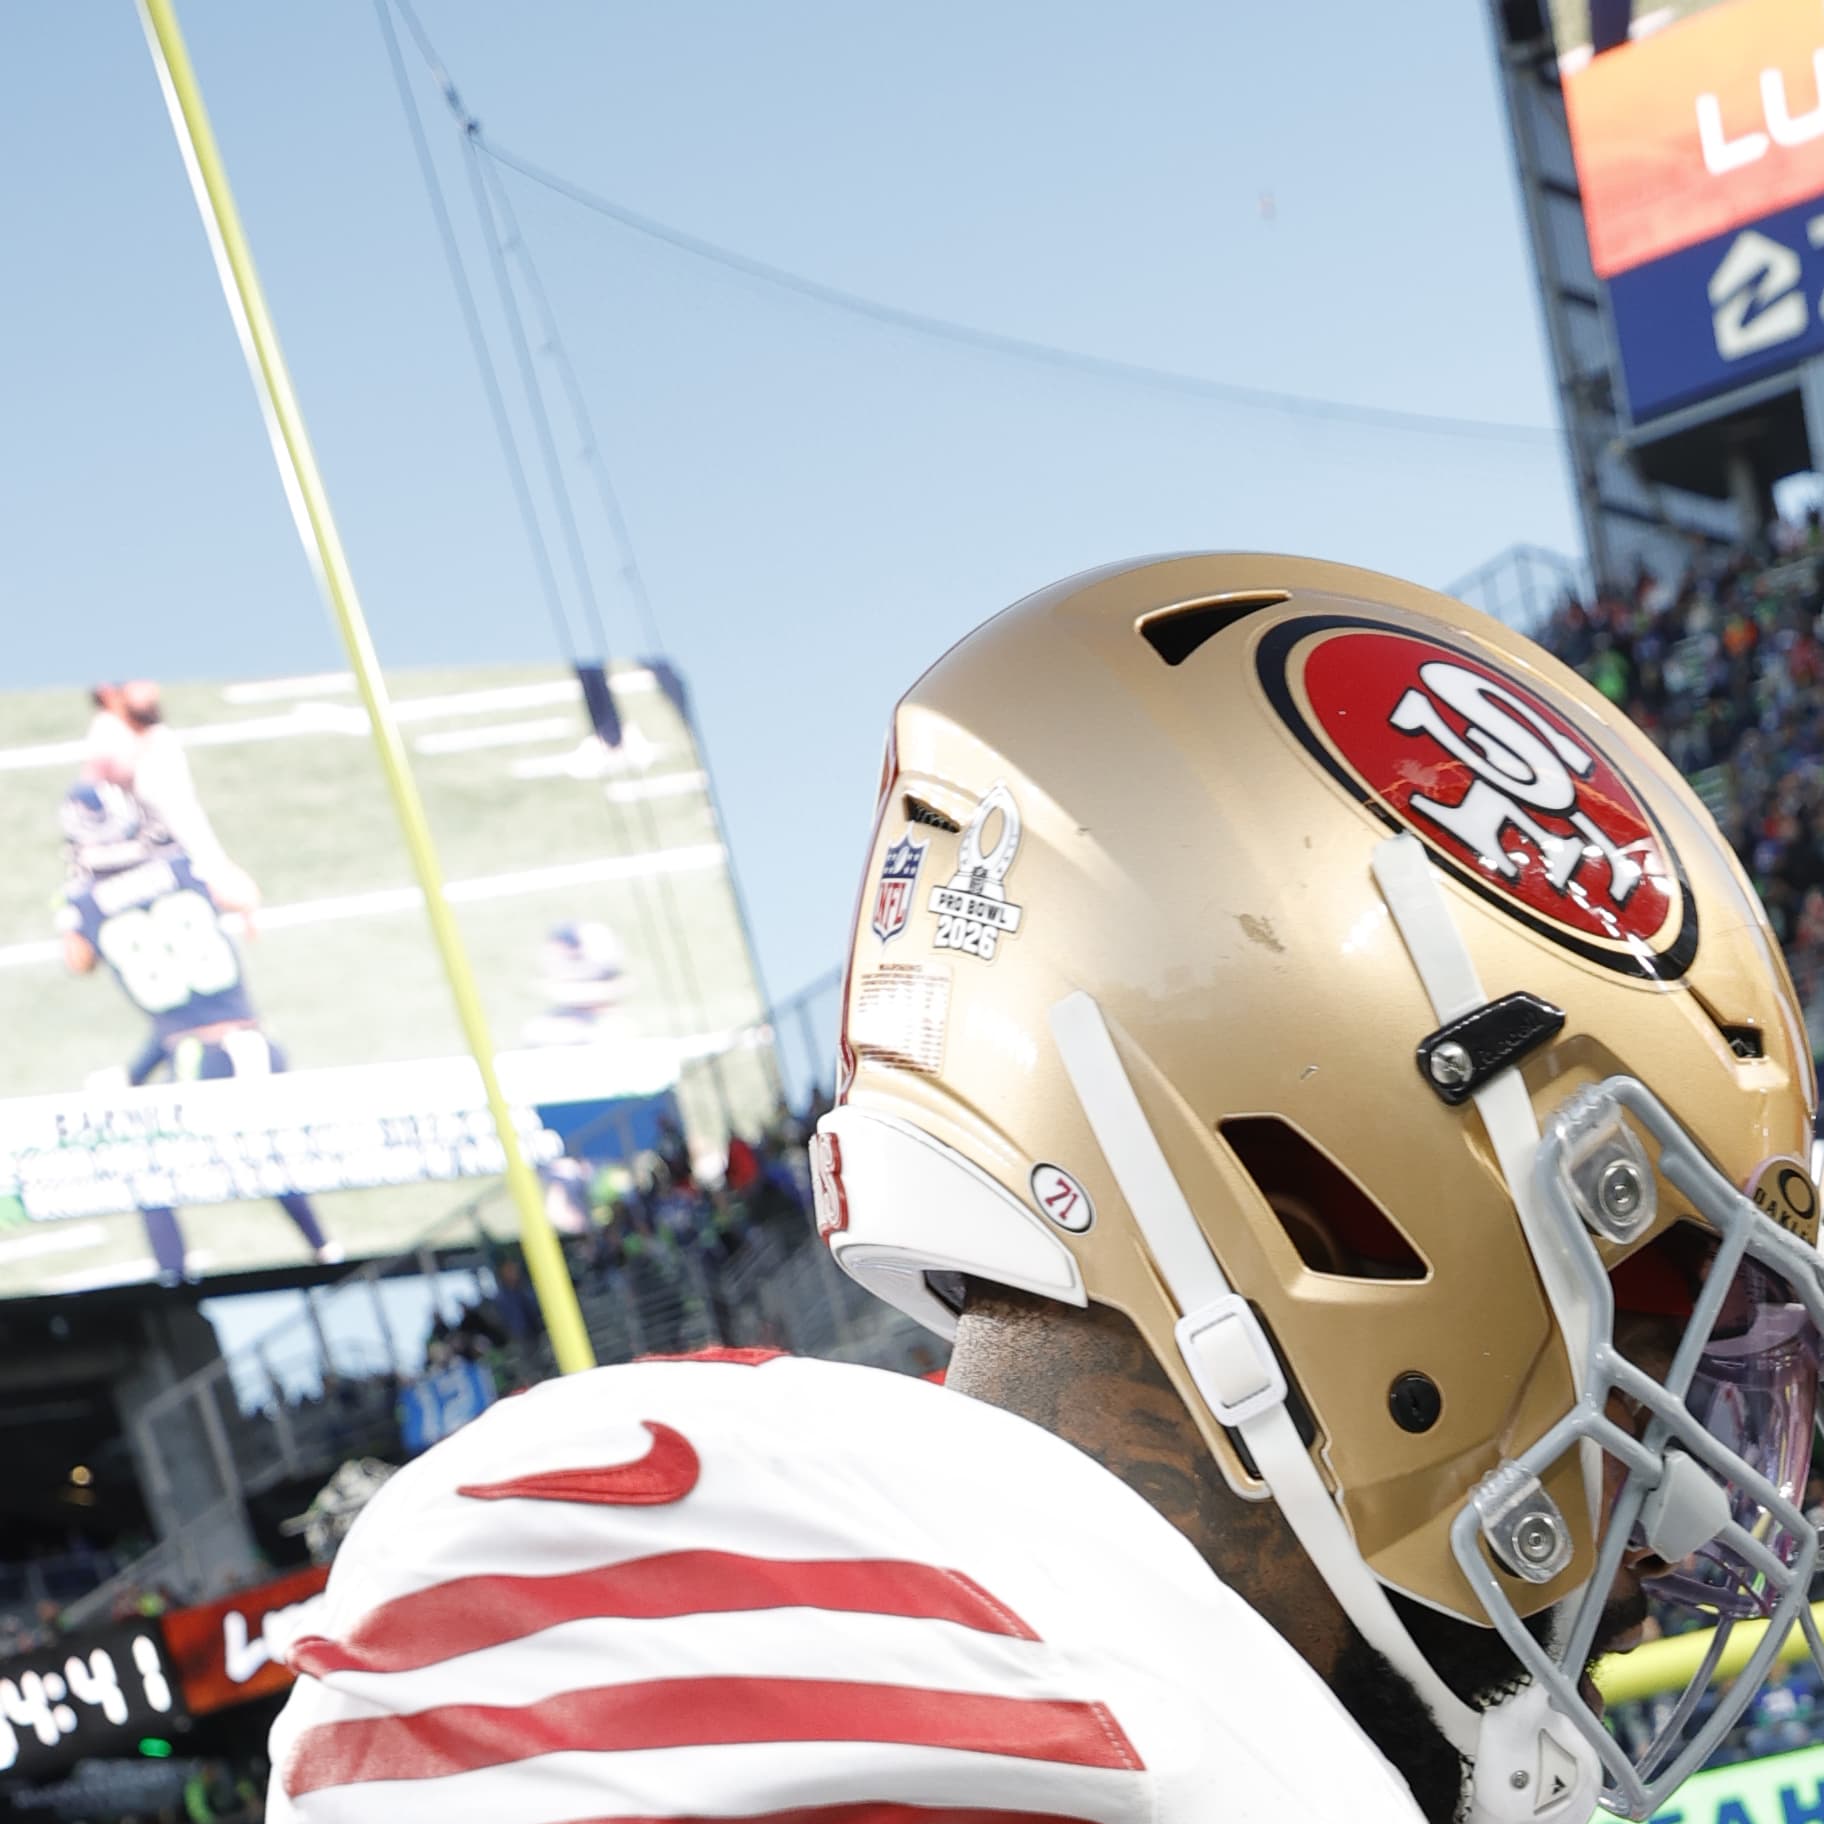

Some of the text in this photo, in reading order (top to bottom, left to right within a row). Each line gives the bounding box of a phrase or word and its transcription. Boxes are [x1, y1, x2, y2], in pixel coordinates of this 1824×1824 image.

[875, 881, 907, 931] NFL
[938, 893, 1006, 923] PRO BOWL
[933, 914, 999, 961] 2026
[1045, 1178, 1079, 1221] 71
[0, 1635, 172, 1770] 4:41
